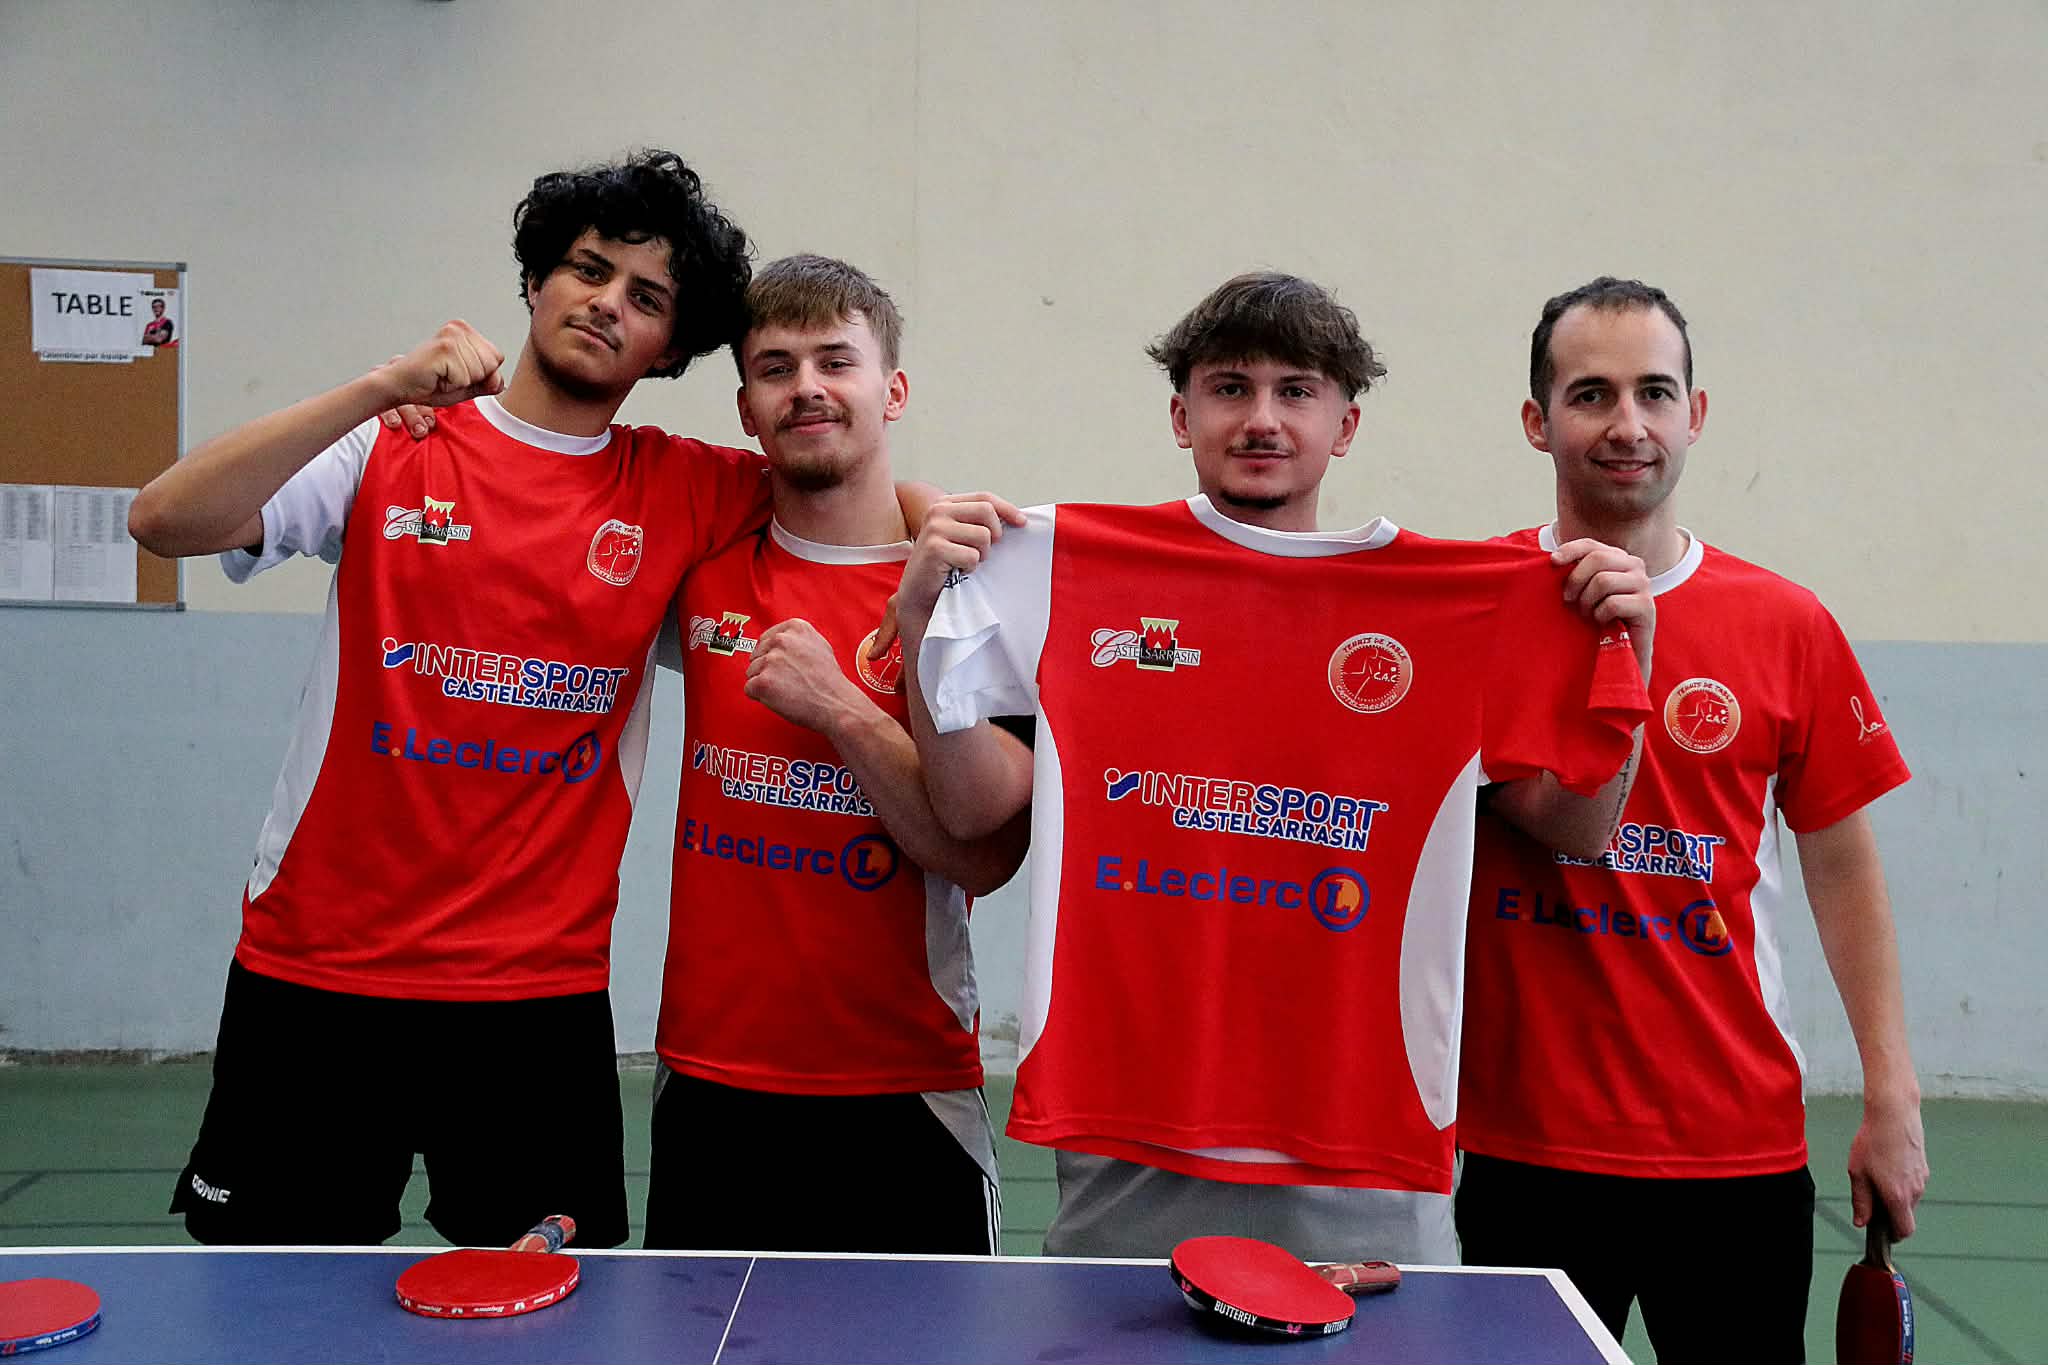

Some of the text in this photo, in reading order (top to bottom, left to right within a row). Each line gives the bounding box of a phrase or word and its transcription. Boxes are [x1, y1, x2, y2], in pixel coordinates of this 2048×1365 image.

[52, 292, 133, 317] TABLE
[384, 506, 471, 540] CASTELSARRASIN
[690, 615, 757, 651] CASTELSARRASIN
[1091, 629, 1200, 668] CASTELSARRASIN
[415, 643, 628, 696] INTERSPORT
[443, 678, 614, 713] CASTELSARRASIN
[371, 721, 560, 775] E.Leclerc
[706, 745, 864, 796] INTERSPO
[722, 777, 881, 817] CASTELSARRAS
[1142, 771, 1382, 832] INTERSPORT
[683, 819, 835, 875] E.Leclerc
[1173, 807, 1369, 851] CASTELSARRASIN
[1612, 823, 1719, 866] SPORT
[1096, 854, 1303, 909] E.Leclerc
[1496, 887, 1673, 941] E.Leclerc
[1214, 1300, 1257, 1327] BUTTERFLY
